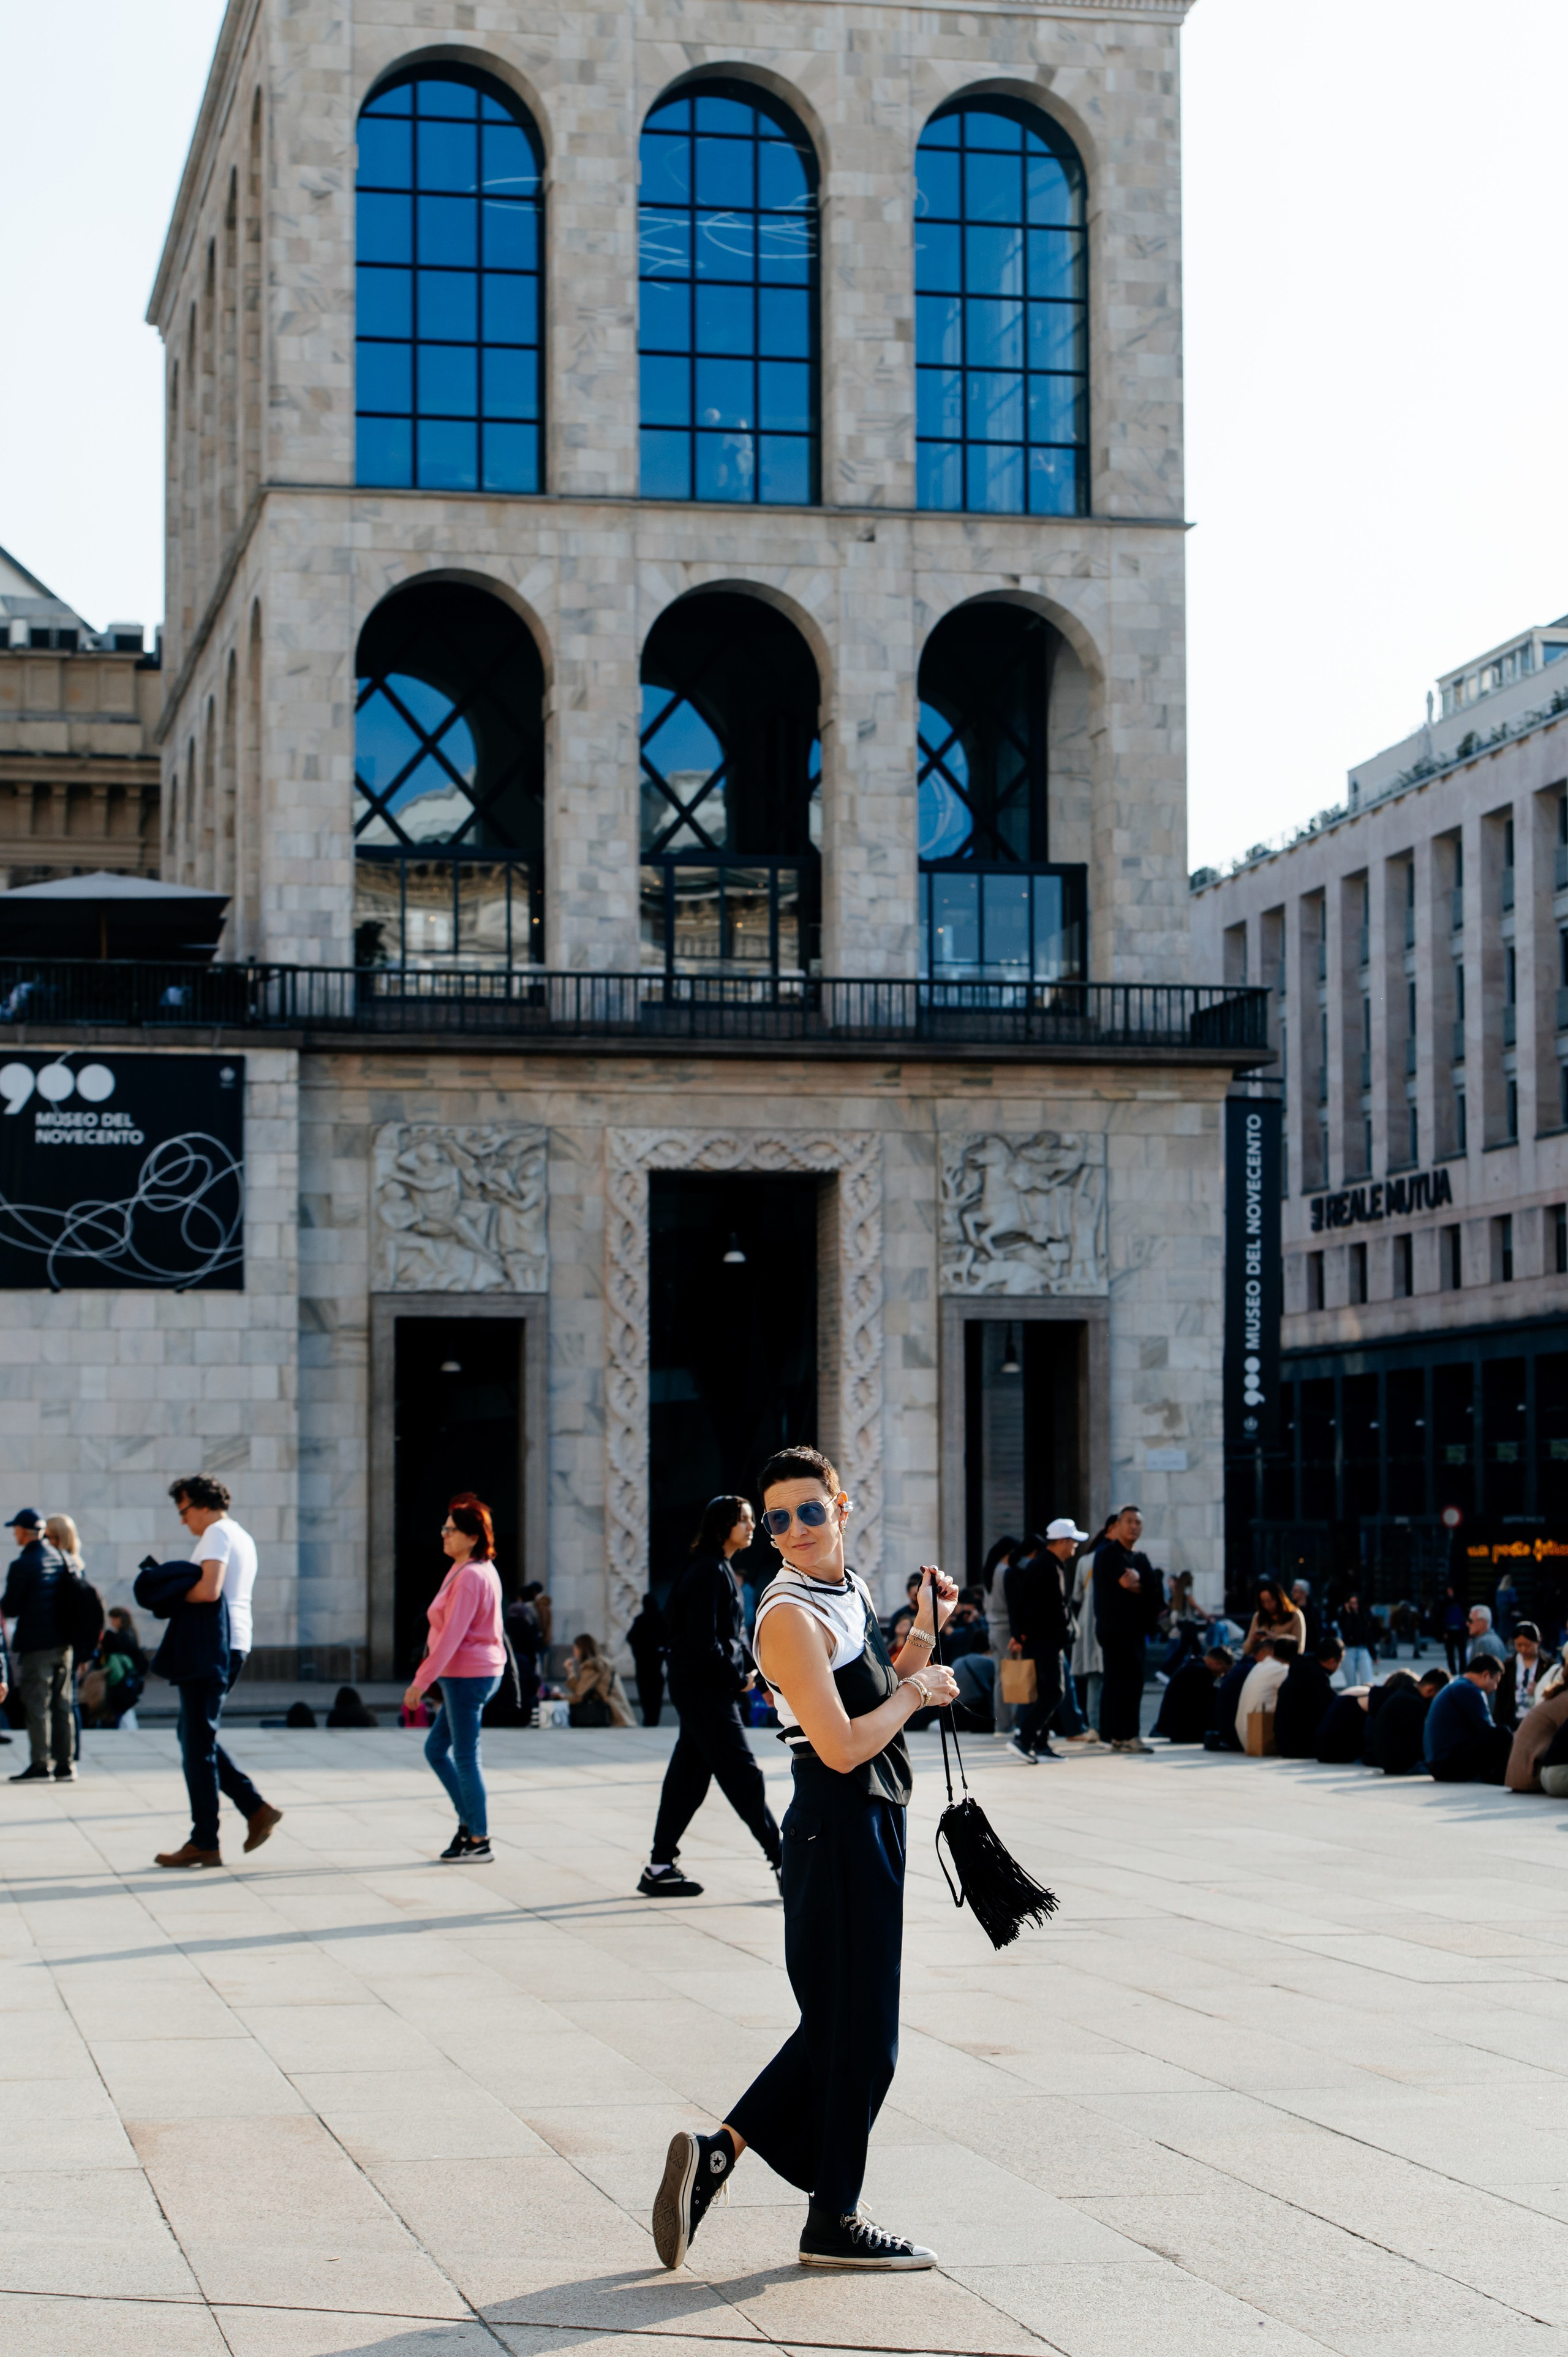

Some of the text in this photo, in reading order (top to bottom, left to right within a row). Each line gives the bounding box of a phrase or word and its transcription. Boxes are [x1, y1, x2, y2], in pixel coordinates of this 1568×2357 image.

[36, 1112, 134, 1128] MUSEO DEL
[36, 1129, 144, 1145] NOVECENTO
[1246, 1114, 1262, 1234] NOVECENTO
[1326, 1168, 1452, 1229] REALE MUTUA
[1246, 1240, 1261, 1275] DEL
[1246, 1280, 1261, 1349] MUSEO
